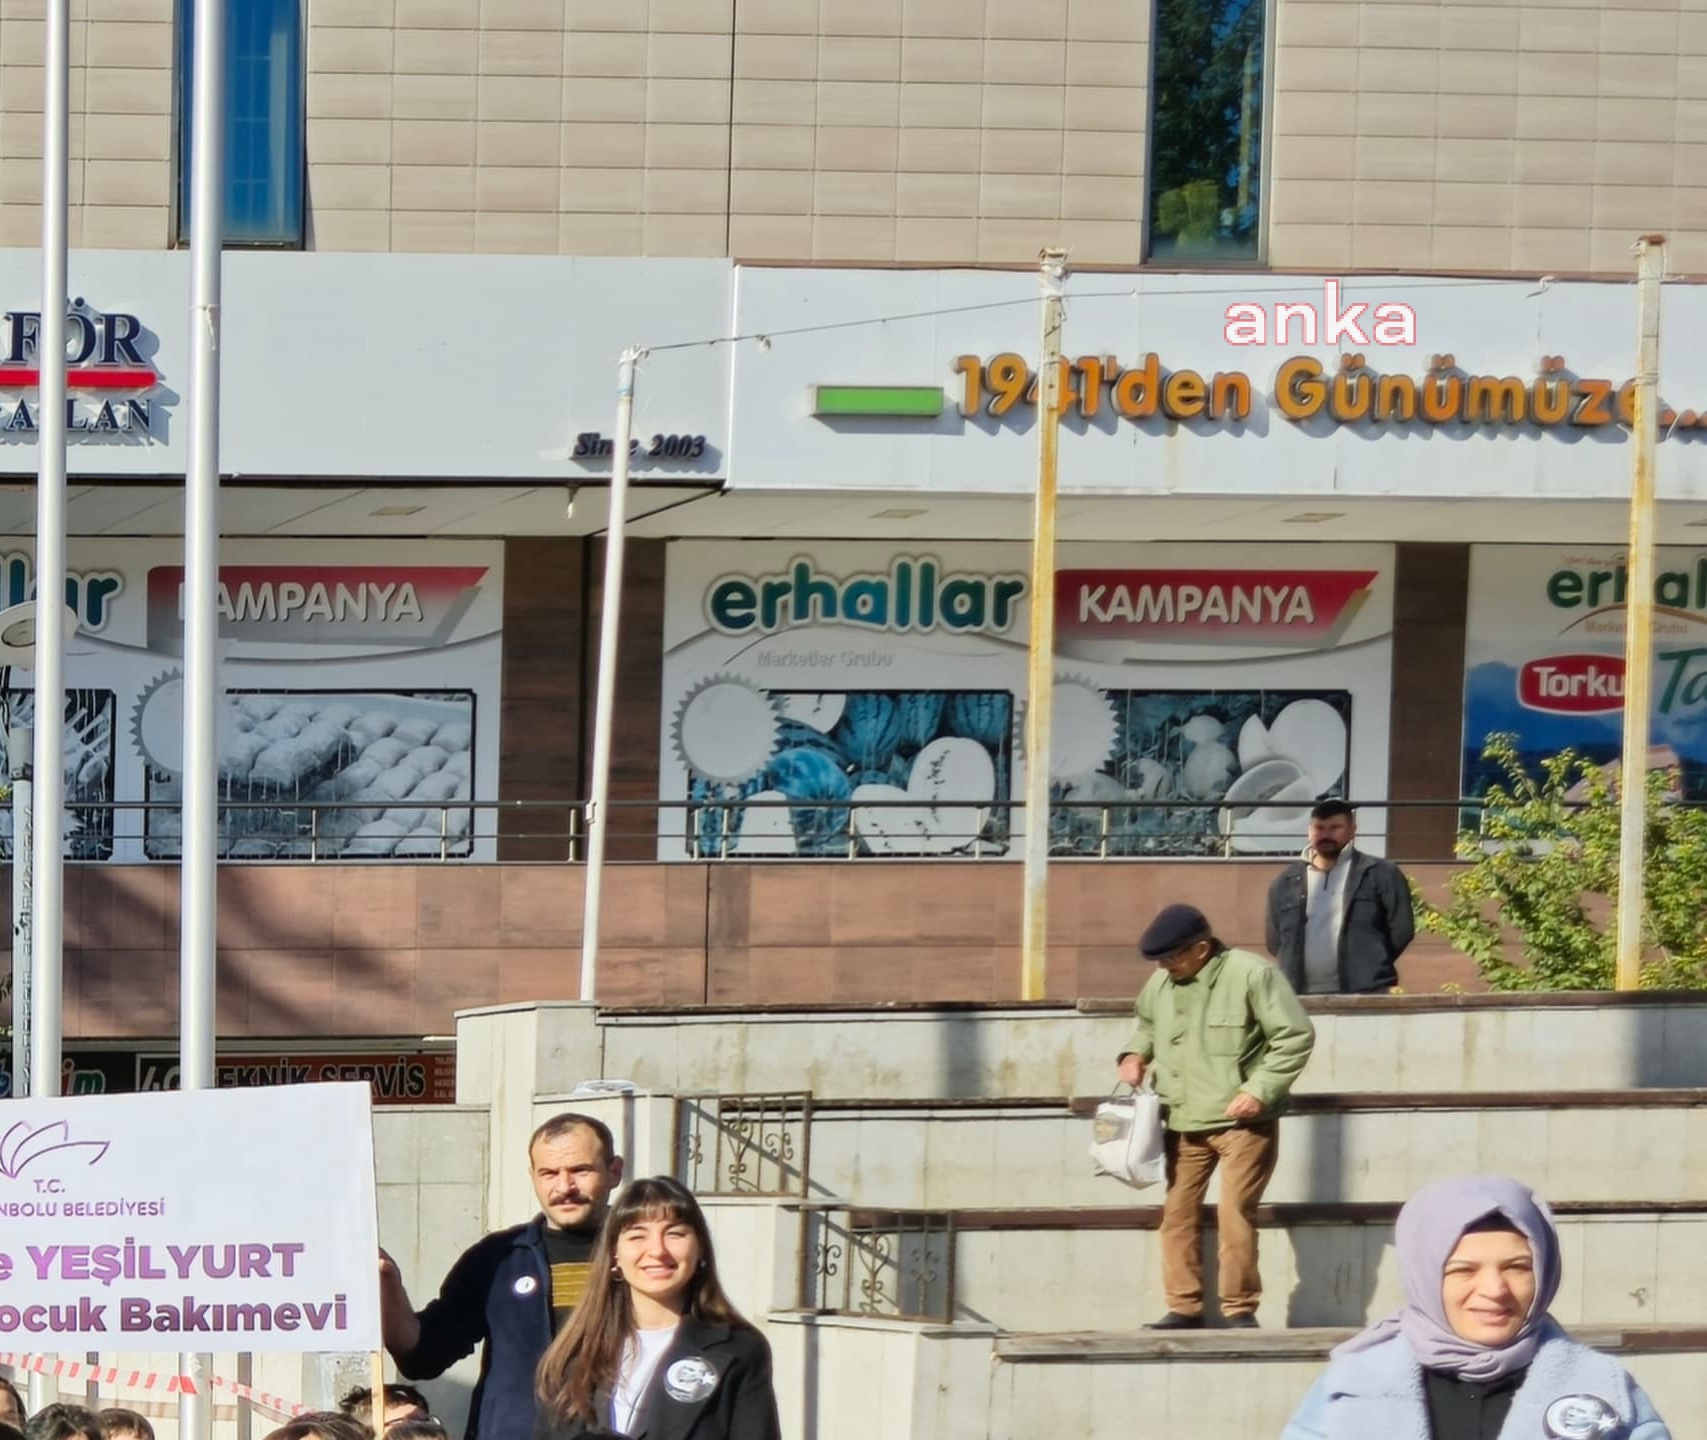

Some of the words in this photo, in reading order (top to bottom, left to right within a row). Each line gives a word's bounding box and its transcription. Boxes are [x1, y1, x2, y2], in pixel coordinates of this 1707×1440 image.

[8, 398, 153, 433] ALAN
[575, 432, 640, 457] Sine
[648, 433, 707, 458] 2003
[710, 561, 1025, 630] erhallar
[1077, 582, 1317, 626] KAMPANYA
[1532, 665, 1627, 698] Torku
[33, 1177, 66, 1194] T.C.
[62, 1195, 166, 1217] BELEDİYESİ
[26, 1236, 306, 1288] YEŞİLYURT
[120, 1293, 347, 1333] Bakımevi
